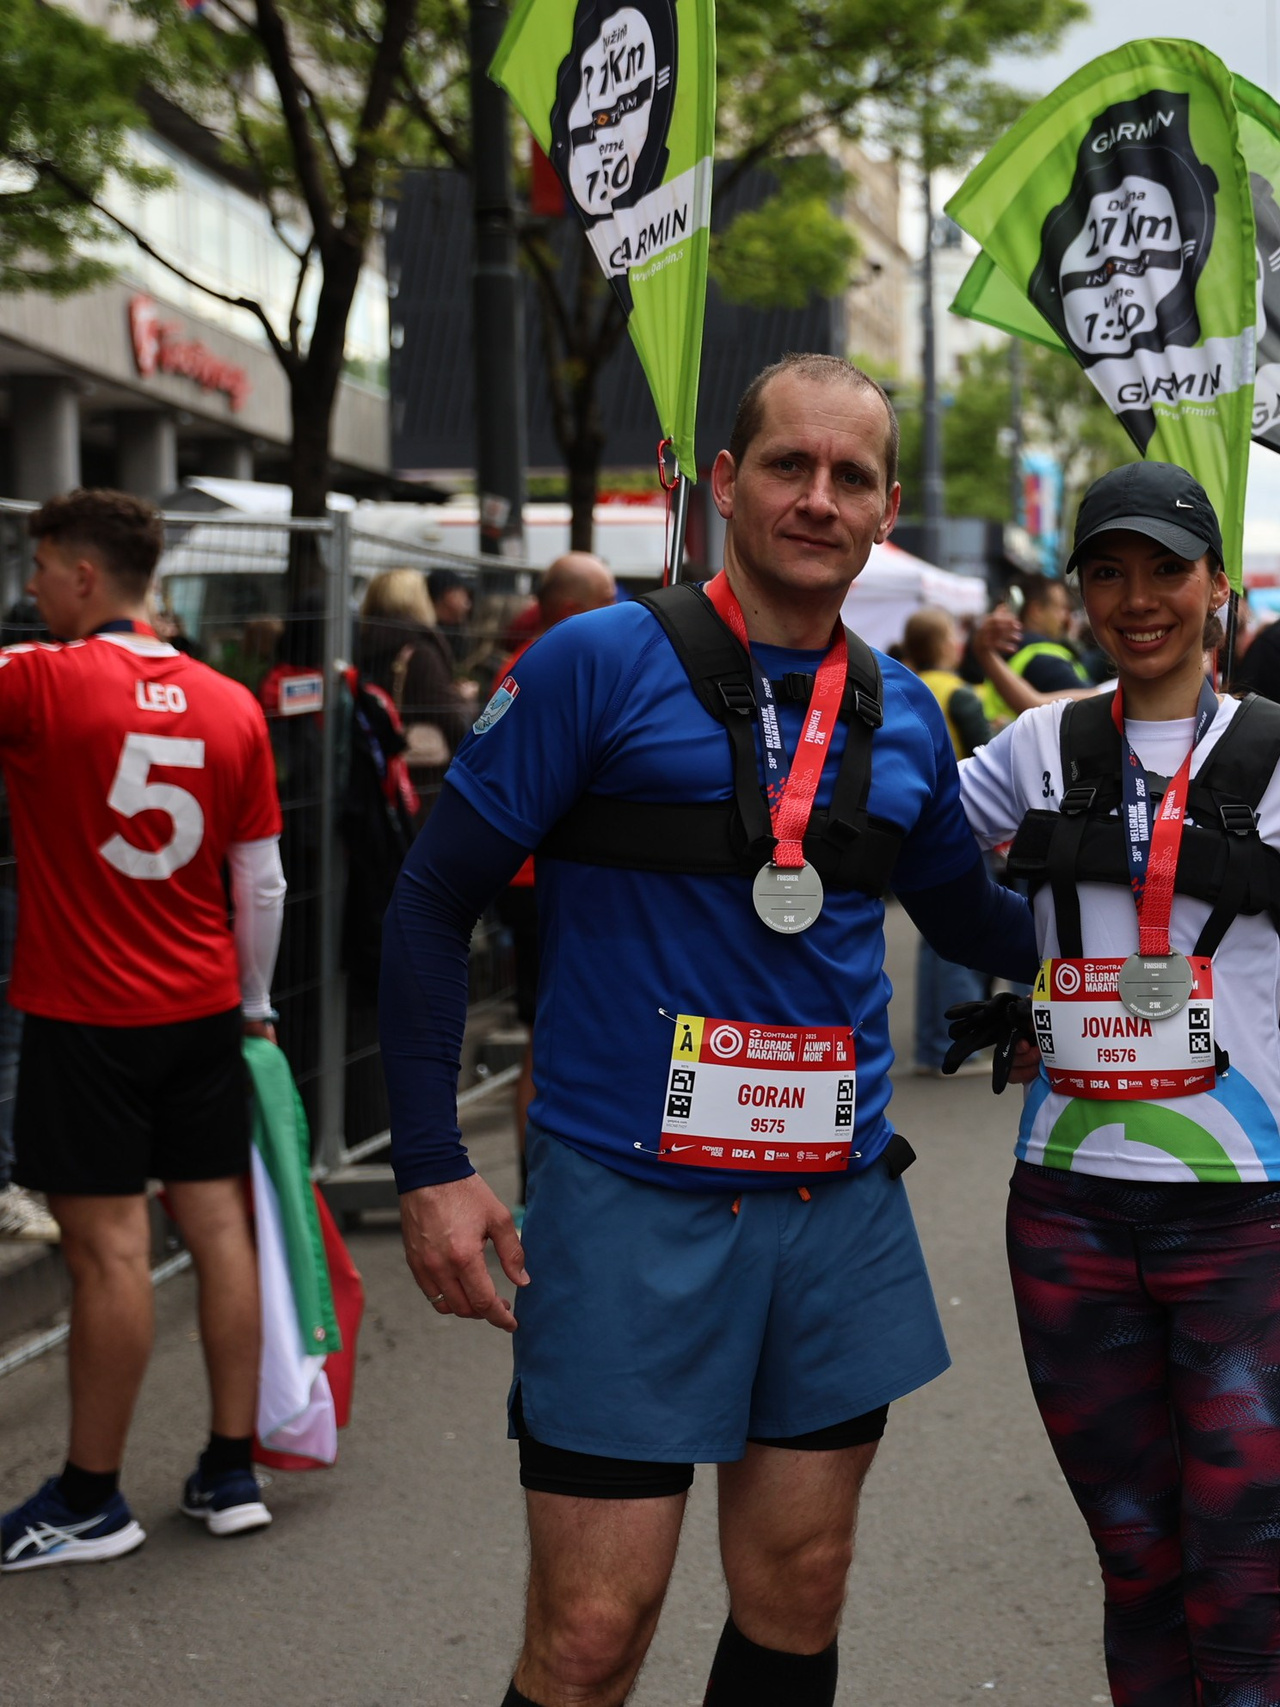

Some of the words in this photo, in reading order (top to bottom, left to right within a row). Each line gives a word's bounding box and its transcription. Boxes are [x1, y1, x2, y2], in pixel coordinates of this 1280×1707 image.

[135, 679, 188, 713] LEO
[765, 677, 773, 699] 2025
[761, 707, 774, 749] BELGRADE
[768, 704, 781, 749] MARATHON
[805, 709, 822, 743] FINISHER
[814, 730, 826, 745] 21K
[1135, 778, 1146, 797] 2025
[99, 731, 206, 881] 5
[1161, 790, 1176, 820] FINISHER
[1171, 806, 1181, 820] 21K
[1128, 804, 1140, 843] BELGRADE
[1137, 801, 1149, 842] MARATHON
[1037, 973, 1046, 992] A
[1085, 972, 1119, 983] BELGRAD
[1085, 982, 1118, 993] MARATH
[1081, 1016, 1153, 1038] JOVANA
[680, 1031, 693, 1052] A
[748, 1038, 792, 1051] BELGRADE
[804, 1041, 831, 1052] ALWAYS
[836, 1041, 843, 1051] 21
[747, 1048, 795, 1062] MARATHON
[802, 1051, 823, 1062] MORE
[836, 1051, 847, 1062] KM
[1097, 1048, 1136, 1063] F9576
[738, 1083, 805, 1109] GORAN
[750, 1117, 785, 1134] 9575
